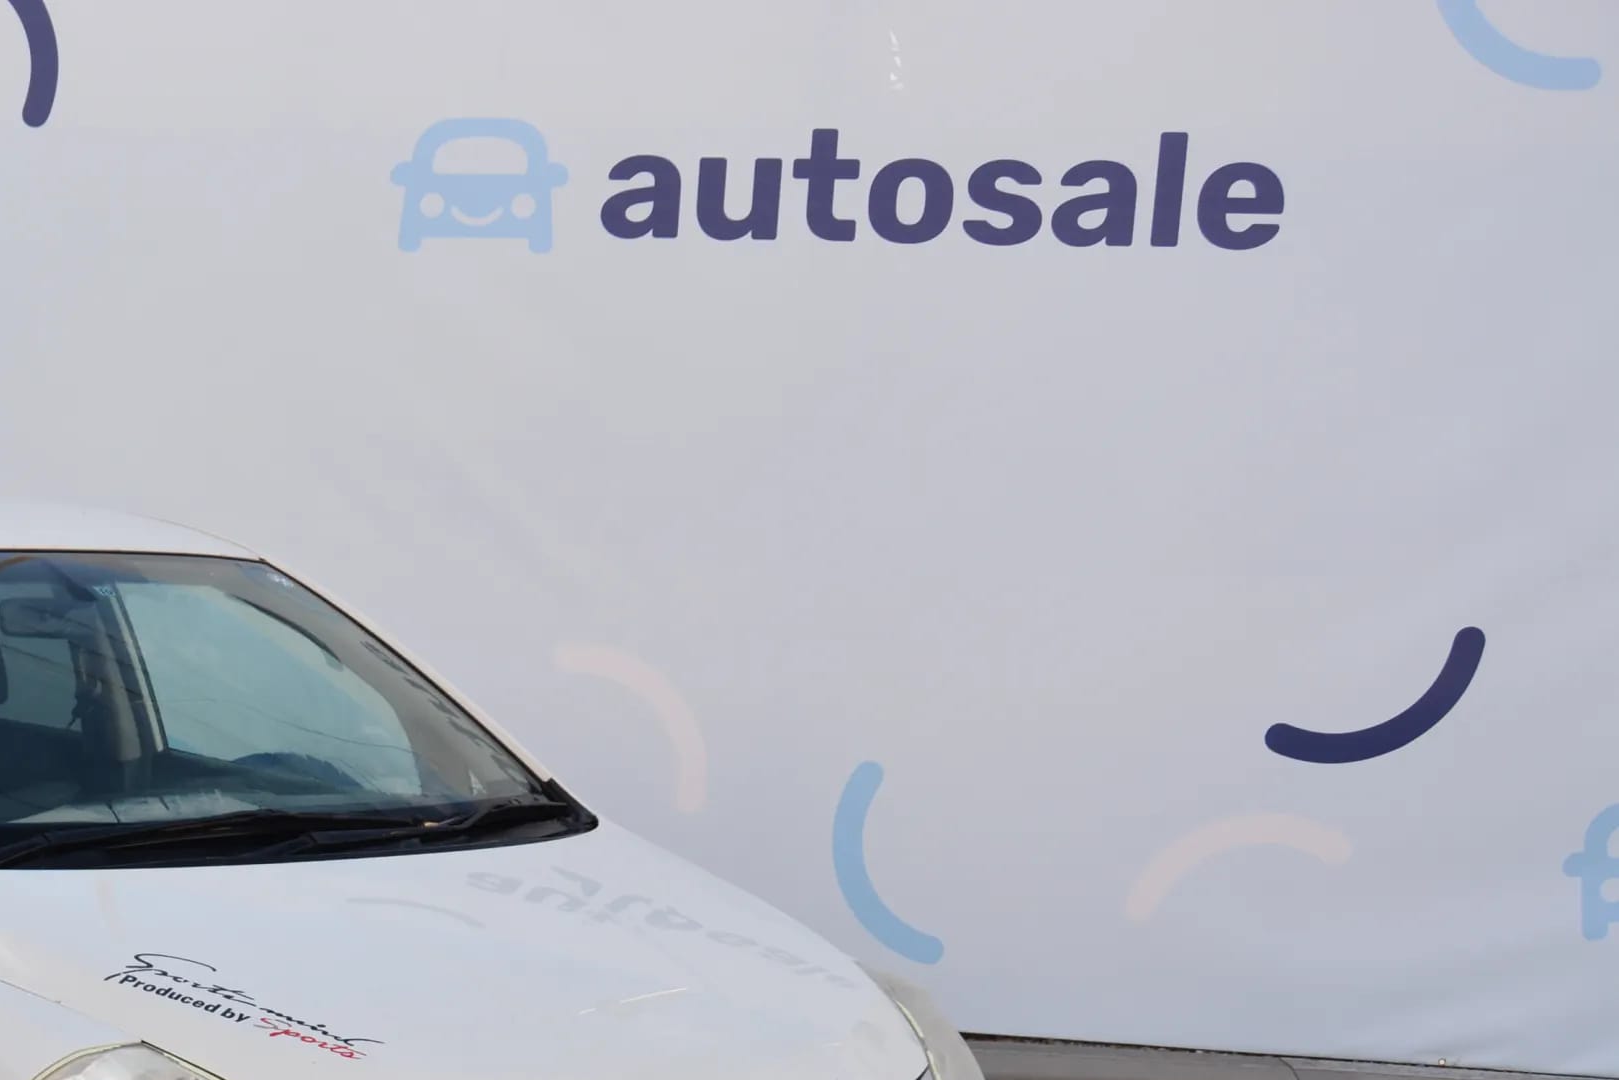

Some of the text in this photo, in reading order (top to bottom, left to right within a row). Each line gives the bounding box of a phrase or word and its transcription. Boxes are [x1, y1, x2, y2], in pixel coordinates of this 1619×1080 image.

[600, 128, 1285, 250] autosale
[118, 974, 367, 1060] Produced by Sports
